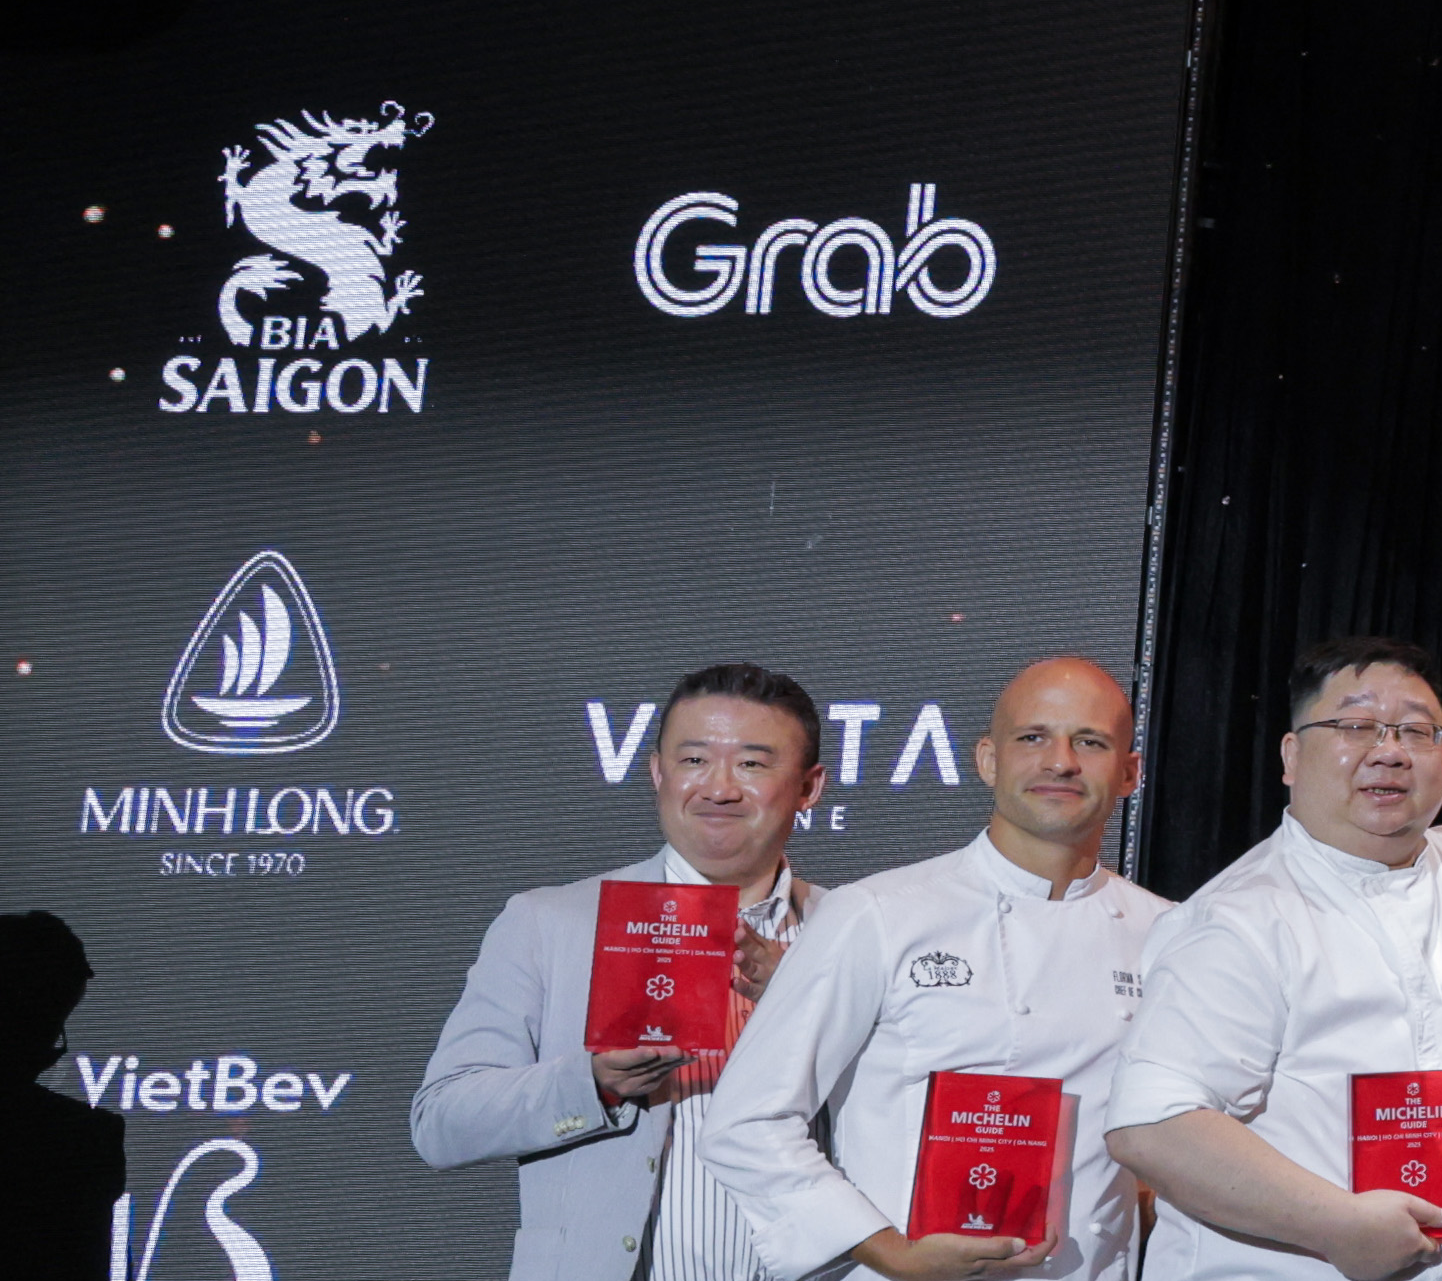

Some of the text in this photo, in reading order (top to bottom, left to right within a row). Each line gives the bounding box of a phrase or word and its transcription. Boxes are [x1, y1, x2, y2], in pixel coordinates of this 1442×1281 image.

[633, 183, 997, 319] Grab
[260, 316, 340, 350] BIA
[159, 355, 429, 413] SAIGON
[586, 702, 960, 785] VTA
[160, 853, 306, 876] SINCE 1970
[627, 922, 708, 937] MICHELIN
[76, 1055, 352, 1111] VietBev
[951, 1112, 1030, 1127] MICHELIN
[984, 1104, 1001, 1112] THE
[1401, 1121, 1427, 1129] GUIDE
